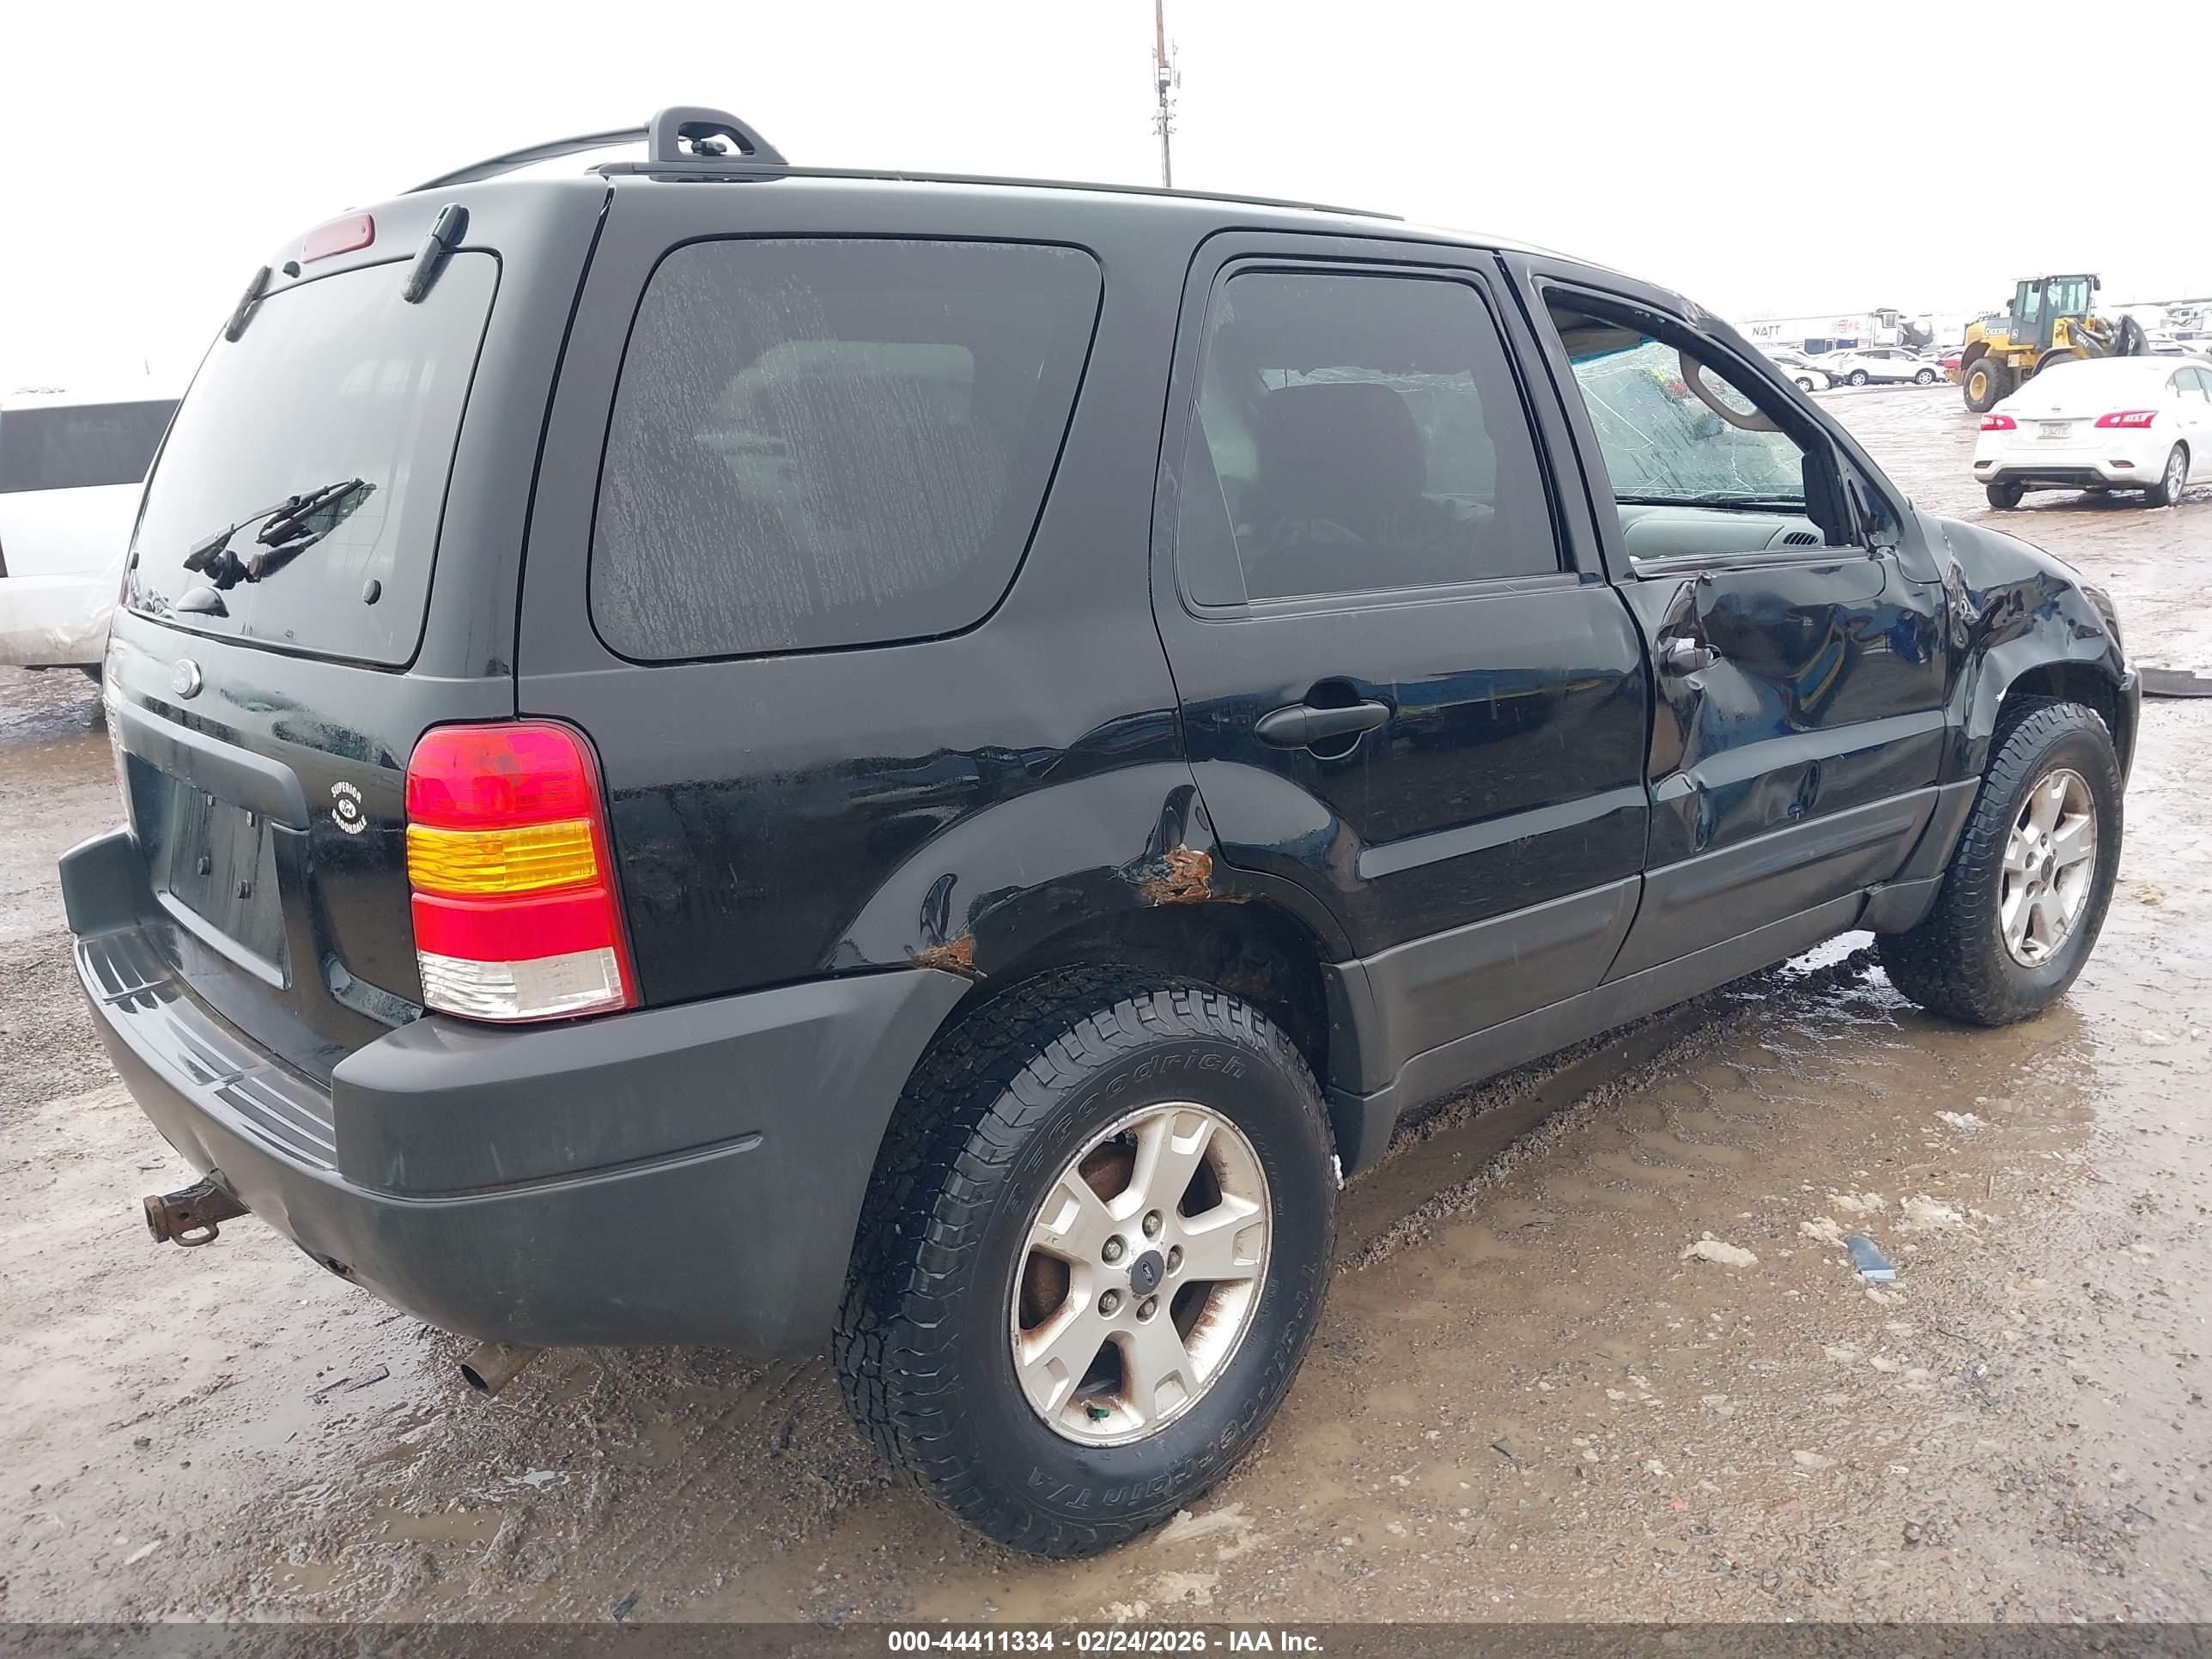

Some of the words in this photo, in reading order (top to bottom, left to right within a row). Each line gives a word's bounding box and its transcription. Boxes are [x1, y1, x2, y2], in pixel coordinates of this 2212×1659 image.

[1753, 325, 1781, 338] NATT
[1985, 327, 2008, 336] DEERE
[331, 781, 362, 804] SUPERIOR
